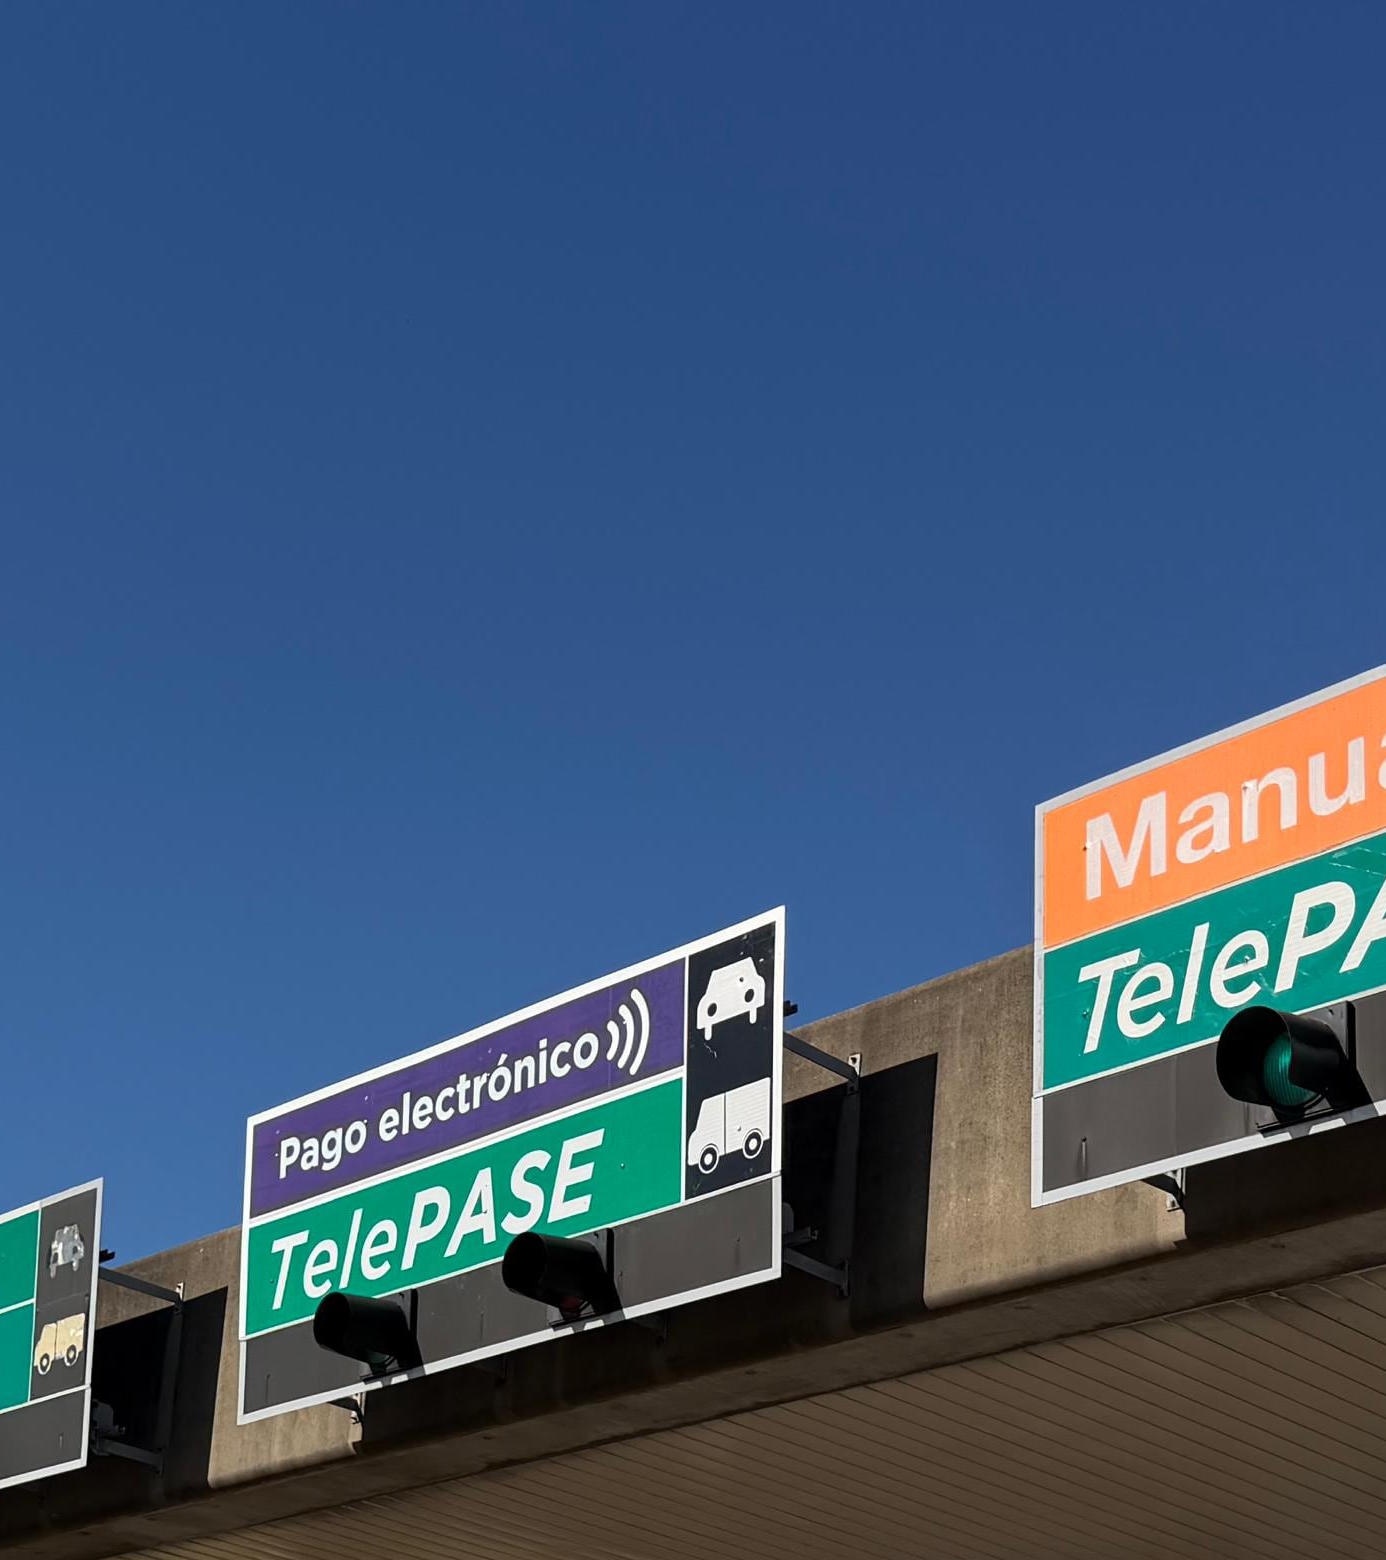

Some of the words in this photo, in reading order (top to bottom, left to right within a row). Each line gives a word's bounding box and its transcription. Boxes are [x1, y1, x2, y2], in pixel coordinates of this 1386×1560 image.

[278, 1118, 368, 1179] Pago
[378, 1031, 599, 1142] electrónico
[269, 1127, 606, 1311] TelePASE
